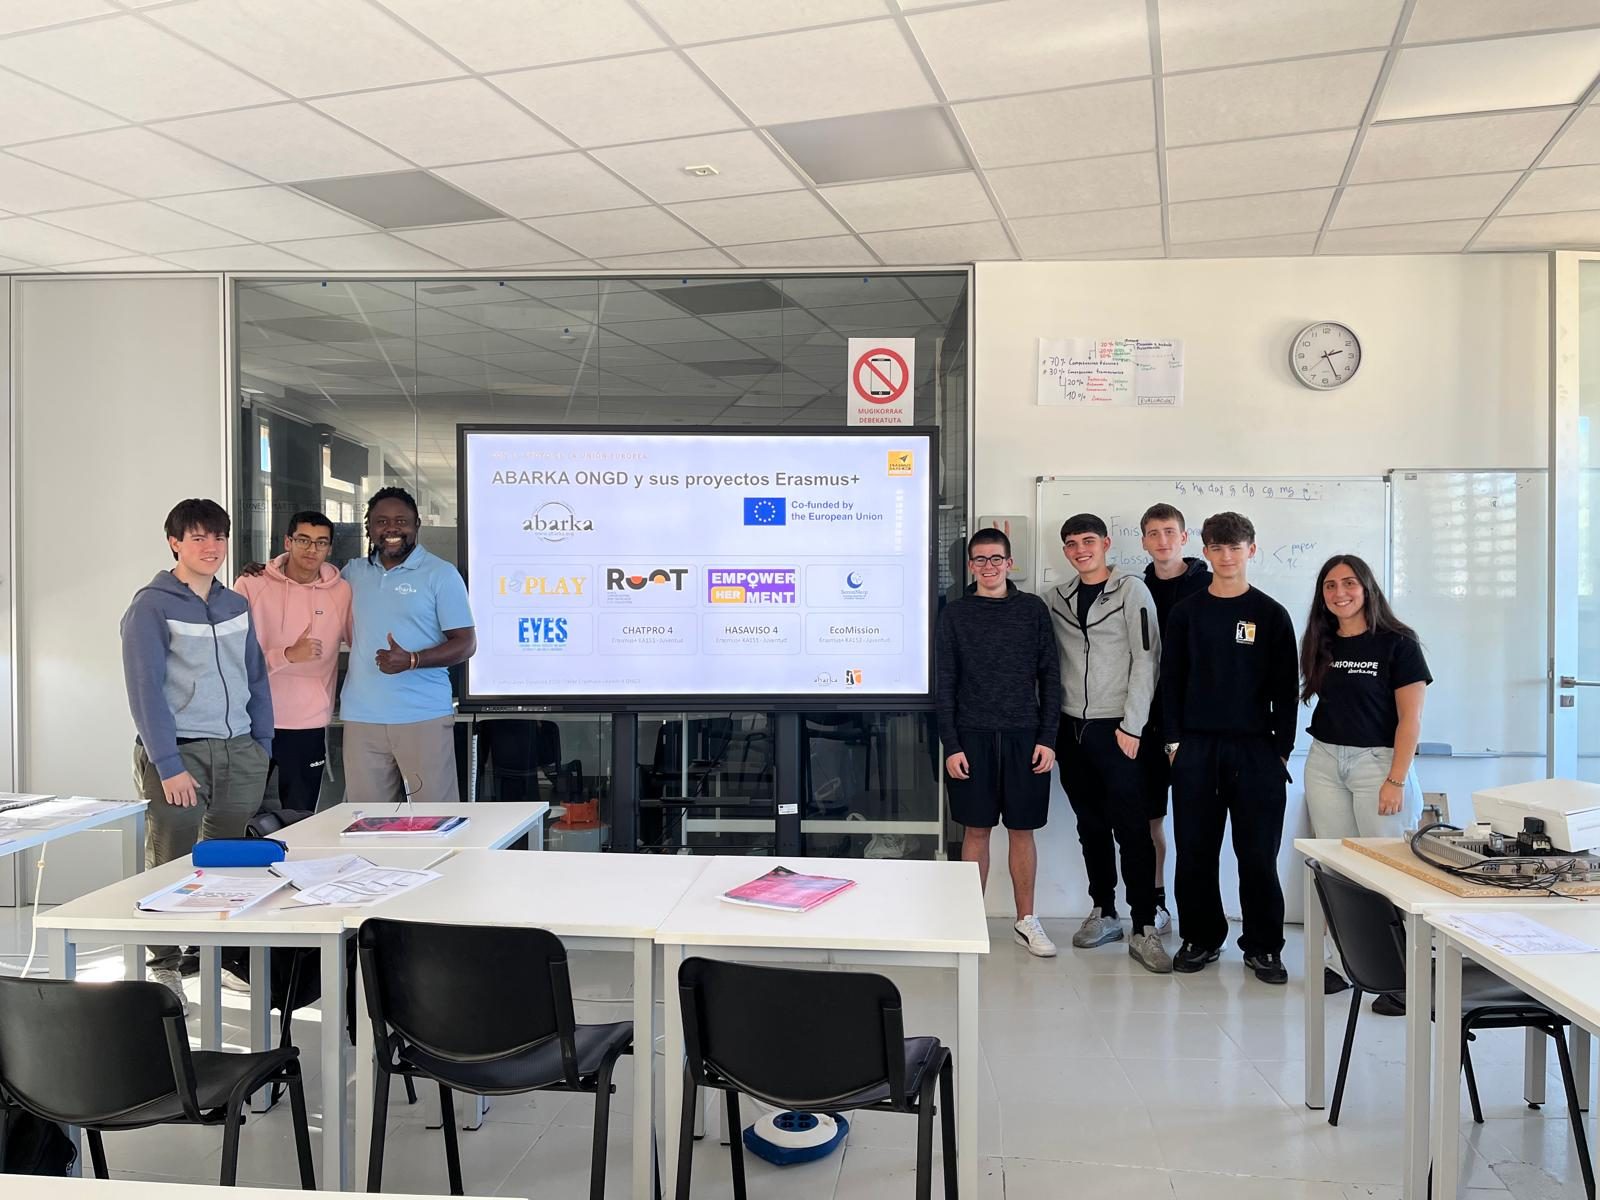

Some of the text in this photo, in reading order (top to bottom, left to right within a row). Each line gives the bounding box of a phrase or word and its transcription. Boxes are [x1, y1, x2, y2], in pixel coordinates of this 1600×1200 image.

[492, 471, 860, 489] ABARKA ONGD y sus proyectos Erasmus+
[791, 500, 854, 511] Co-funded by
[522, 514, 594, 531] abarka
[791, 512, 883, 523] the European Union
[1110, 516, 1140, 537] Finis
[523, 576, 587, 596] PLAY
[711, 572, 796, 589] EMPOWER
[715, 590, 741, 600] HER
[746, 591, 794, 604] MENT
[518, 617, 568, 643] EYES
[622, 626, 673, 635] CHATPRO 4
[725, 626, 778, 635] HASAVISO 4
[829, 625, 880, 635] EcoMission
[1329, 661, 1378, 669] ARFORHOPE
